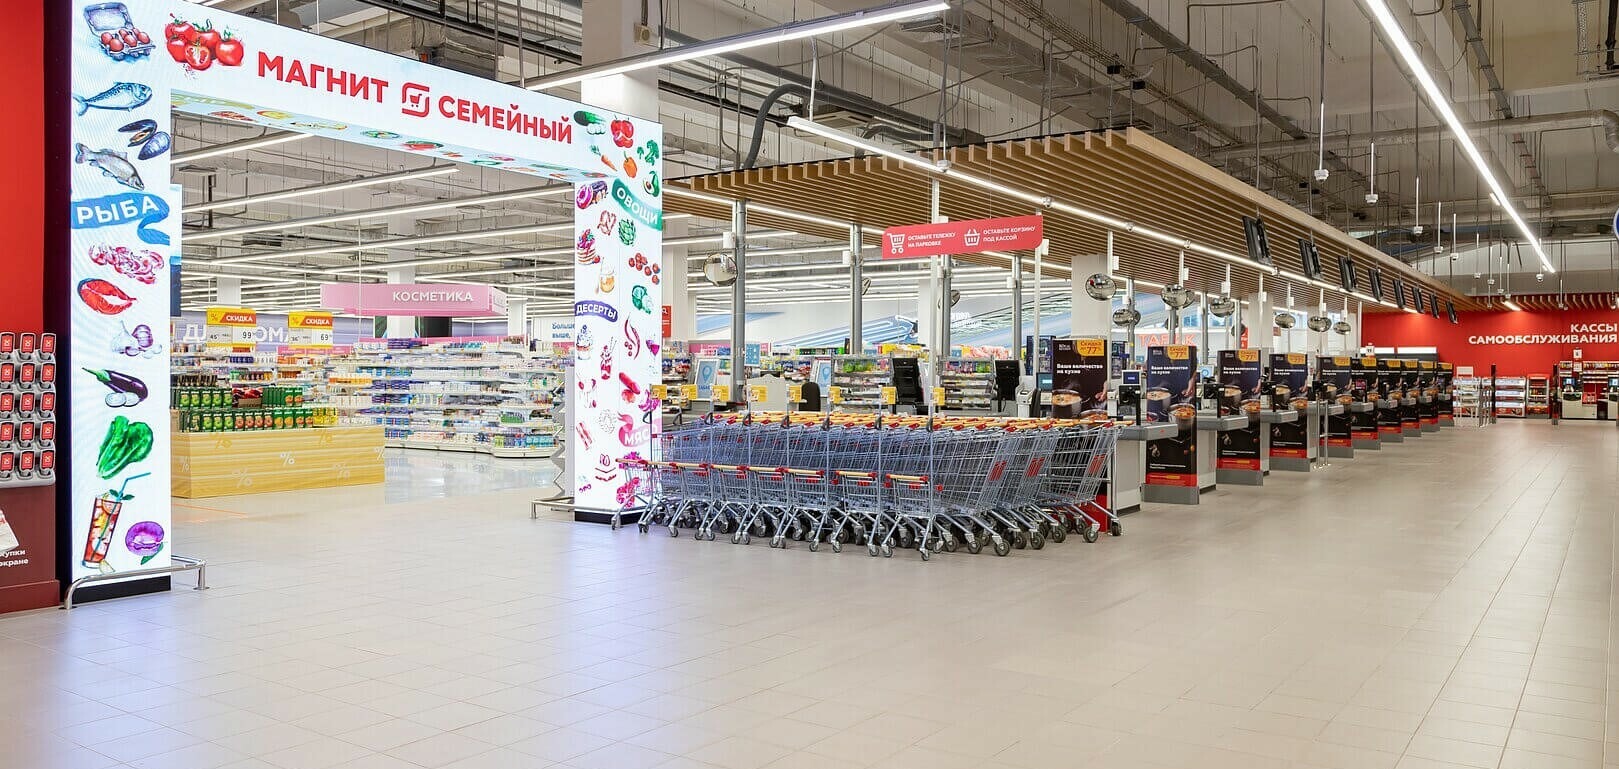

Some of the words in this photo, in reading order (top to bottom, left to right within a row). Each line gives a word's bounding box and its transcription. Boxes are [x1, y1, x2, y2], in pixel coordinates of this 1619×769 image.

[257, 51, 389, 104] МАГНИТ
[437, 95, 573, 144] СЕМЕЙНЫЙ
[76, 195, 160, 225] РЫБА
[616, 187, 659, 225] ОВОЩИ
[393, 291, 474, 302] КОСМЕТИКА
[576, 303, 617, 319] ДЕСЕРТЫ
[1570, 323, 1618, 333] КАССЫ
[242, 331, 252, 339] 99
[320, 333, 329, 341] 69
[1468, 334, 1618, 345] САМООБСЛУЖИВАНИЯ
[624, 423, 658, 446] МЯСО
